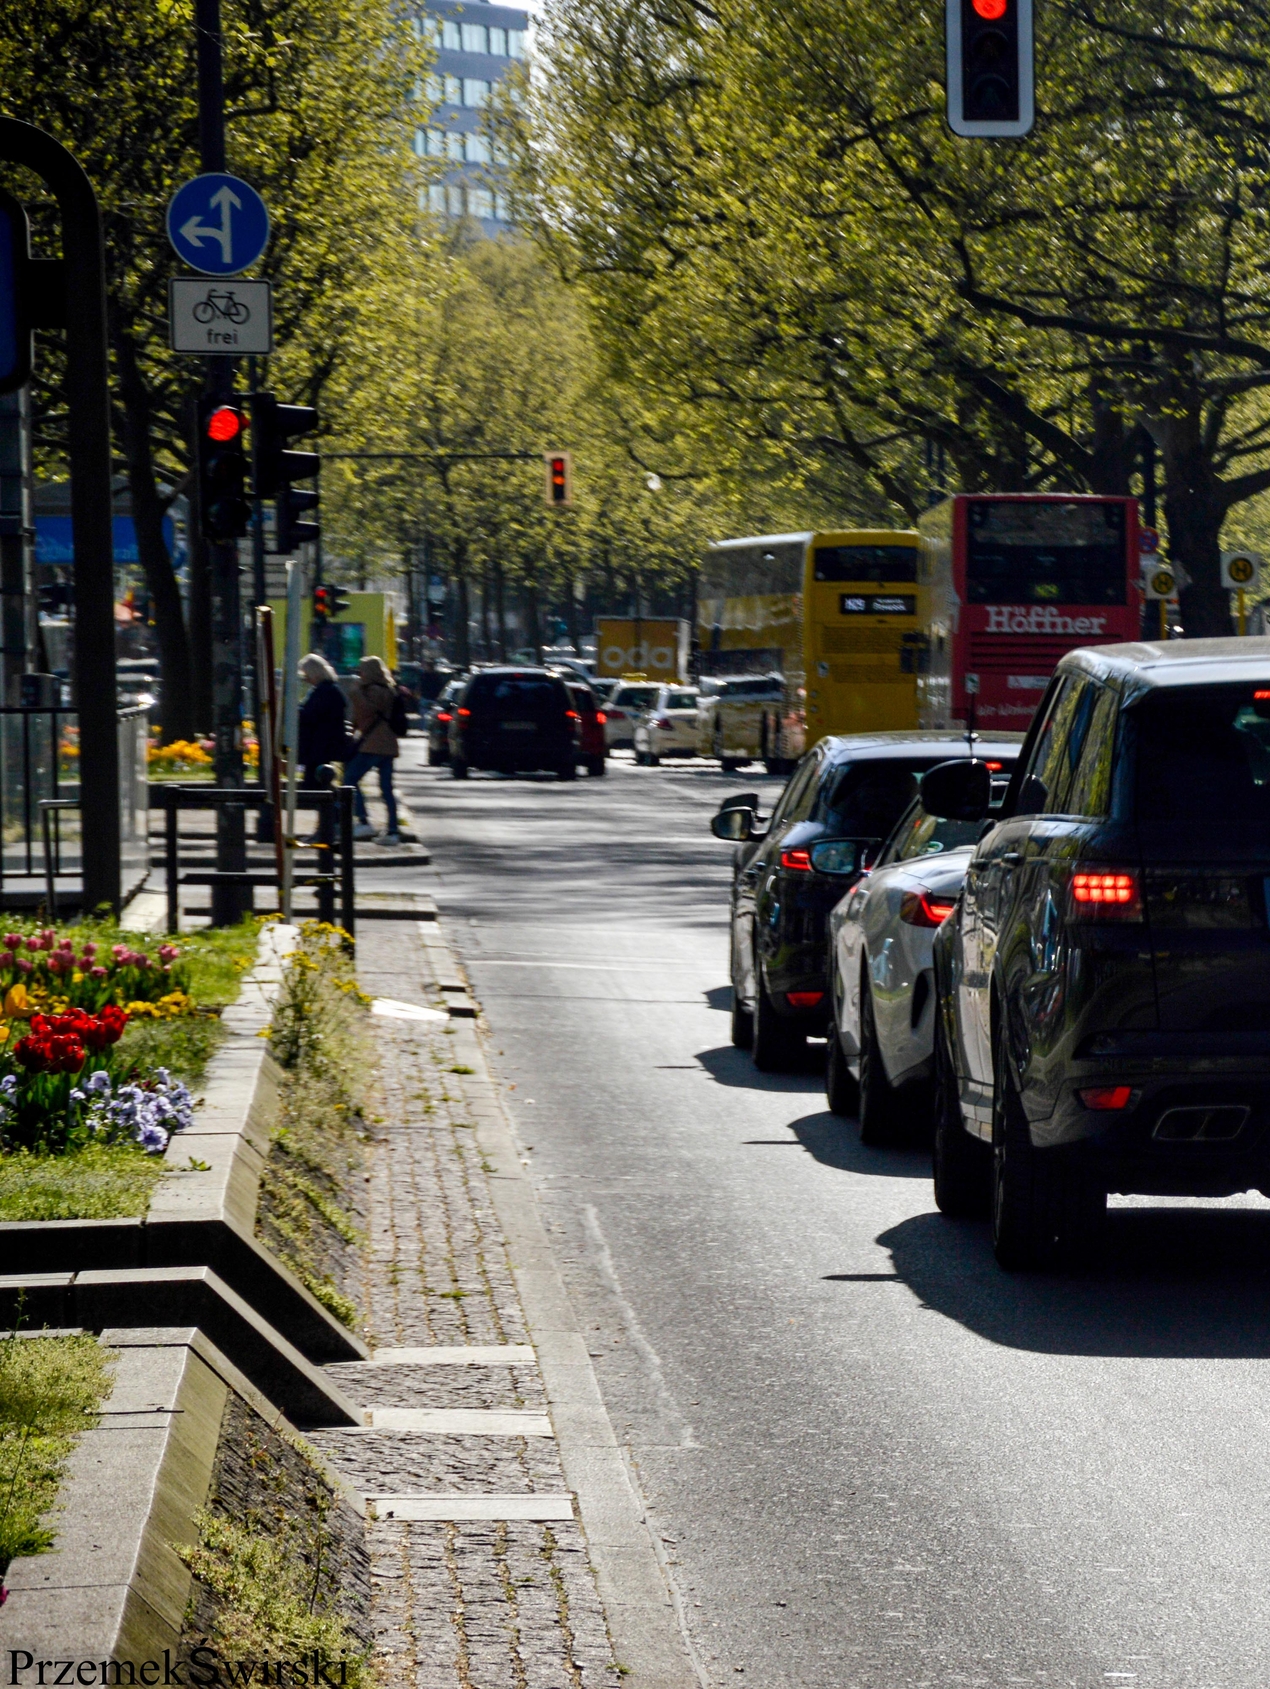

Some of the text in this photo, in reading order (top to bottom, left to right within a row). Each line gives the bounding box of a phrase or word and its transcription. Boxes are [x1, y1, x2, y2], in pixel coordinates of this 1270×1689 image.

[207, 328, 239, 345] frei
[985, 605, 1107, 635] Höffner
[603, 641, 673, 669] oda
